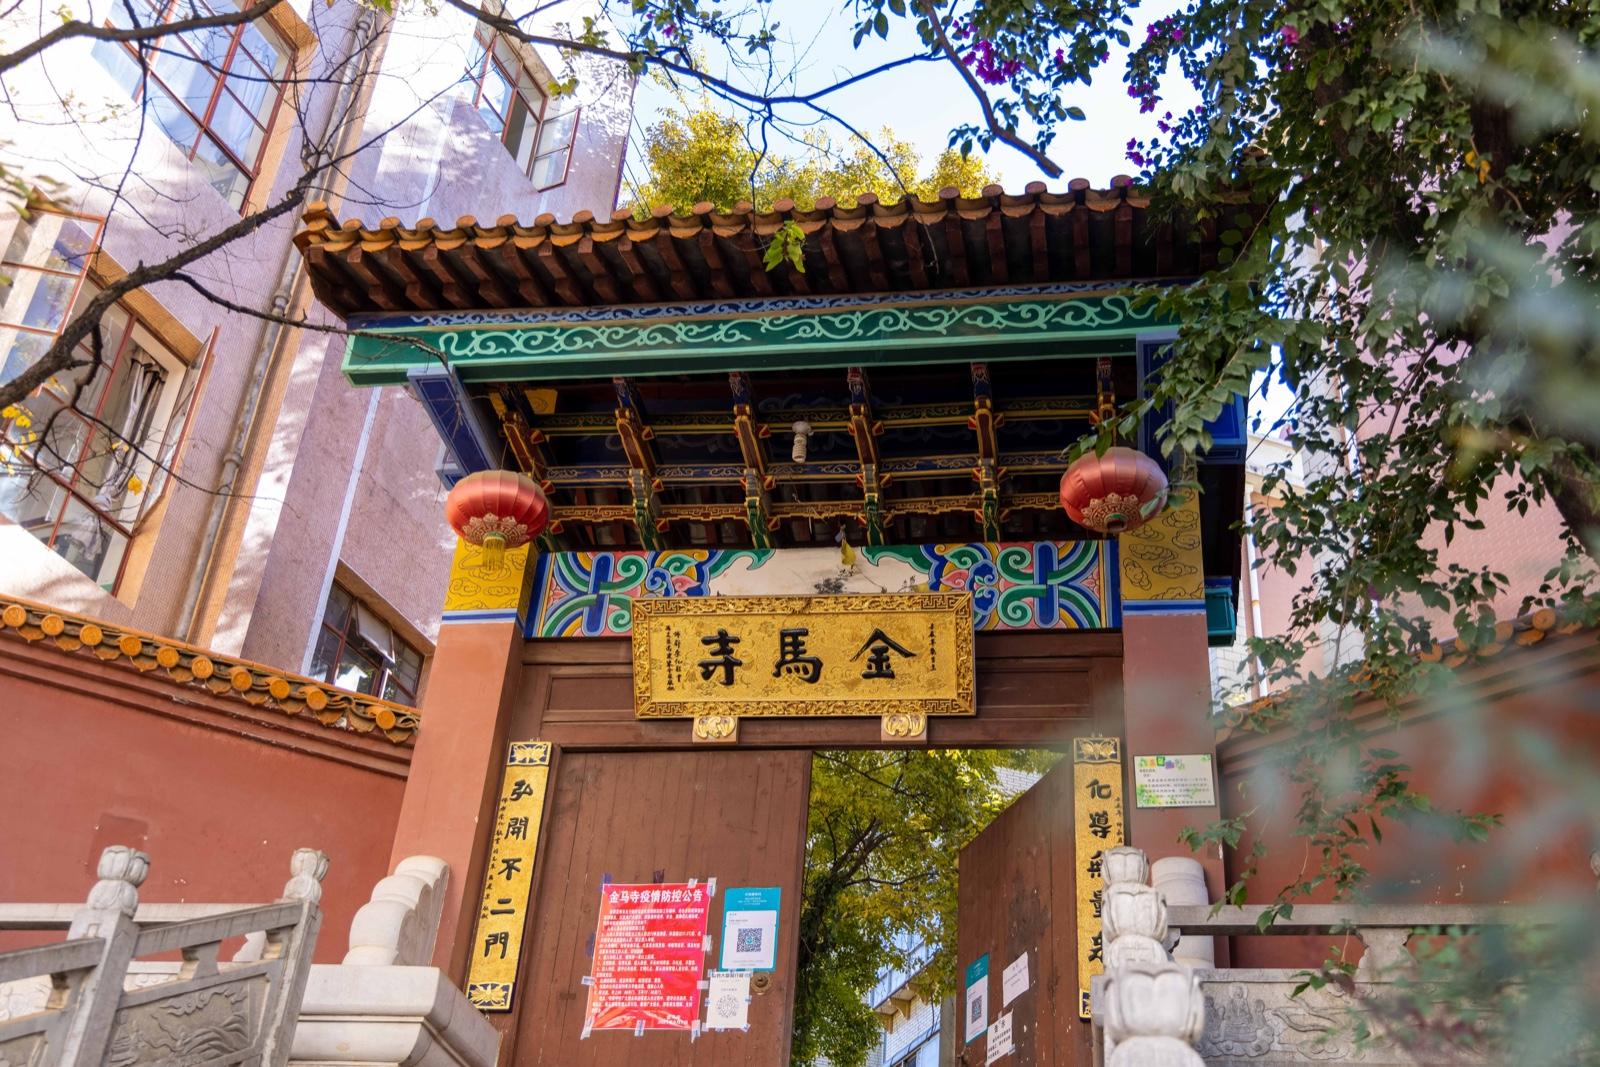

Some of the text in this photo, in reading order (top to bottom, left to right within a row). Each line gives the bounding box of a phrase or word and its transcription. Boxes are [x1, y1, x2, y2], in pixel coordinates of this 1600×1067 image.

[697, 628, 917, 686] 金馬寺
[484, 779, 533, 959] 弘開不二門
[609, 889, 703, 904] 金马寺疫情防控公告
